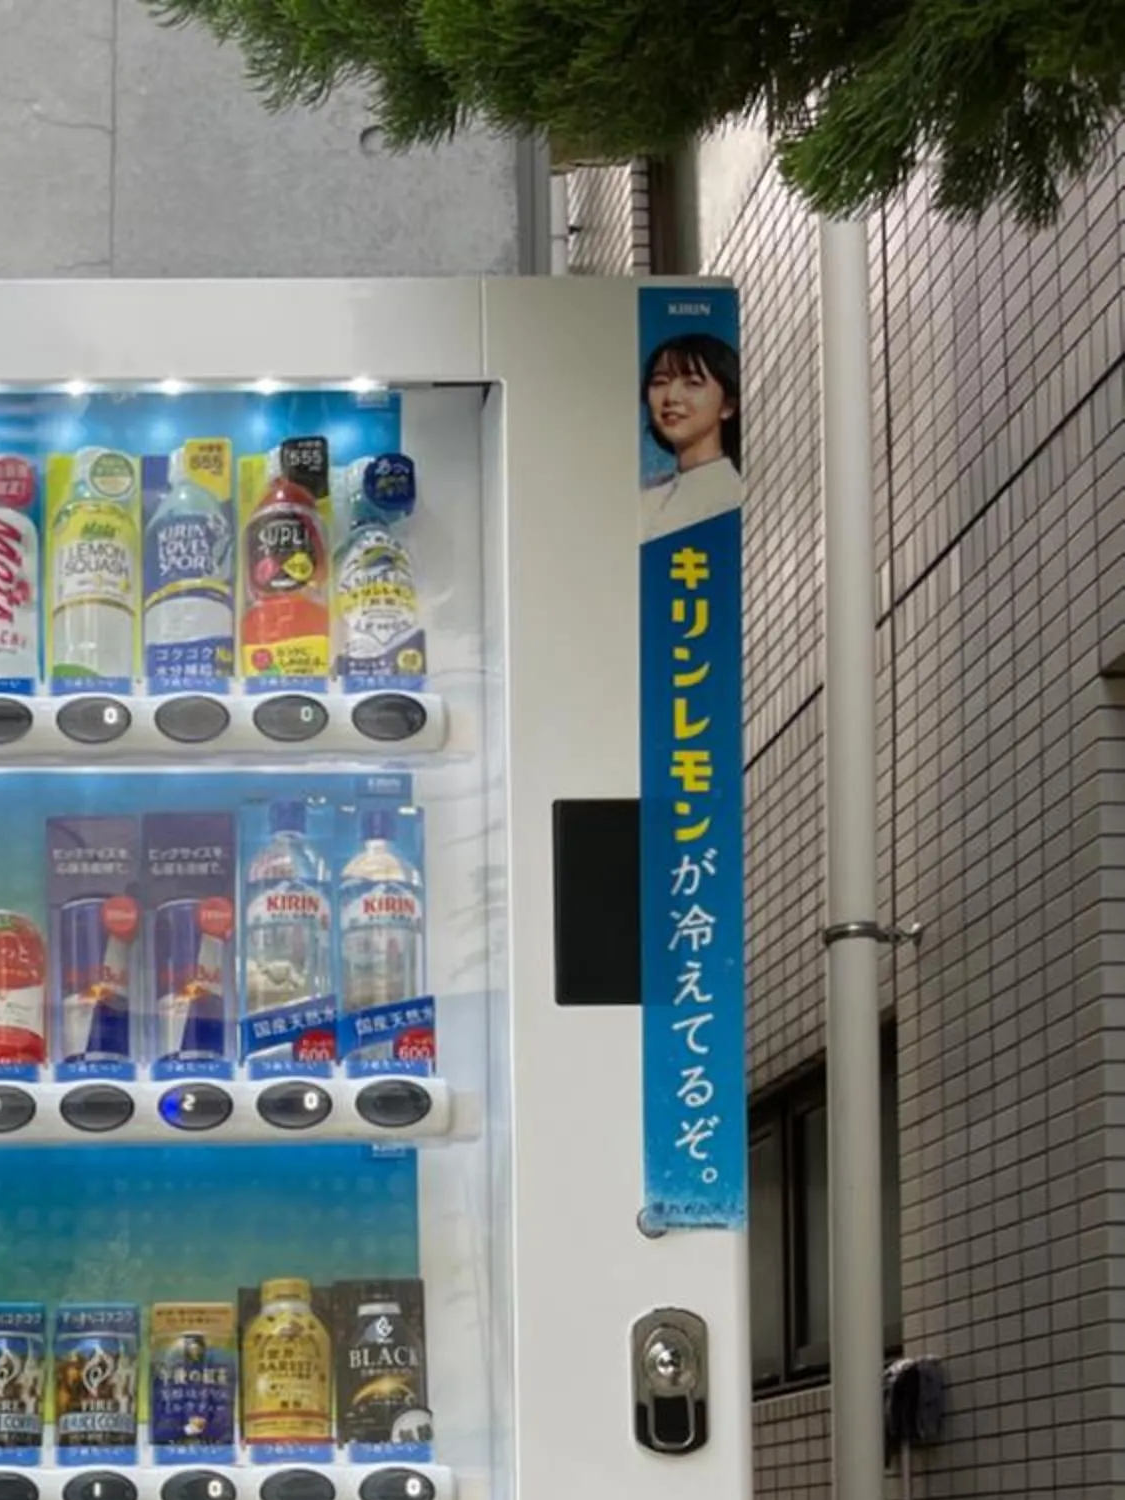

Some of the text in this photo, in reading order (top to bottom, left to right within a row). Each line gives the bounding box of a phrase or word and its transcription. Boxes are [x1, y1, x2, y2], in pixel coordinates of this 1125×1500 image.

[666, 547, 720, 1184] キリンレモンが冷えてるぞ。
[266, 894, 320, 912] KIRIN
[363, 896, 416, 915] KIRIN
[349, 1345, 420, 1369] BLACK
